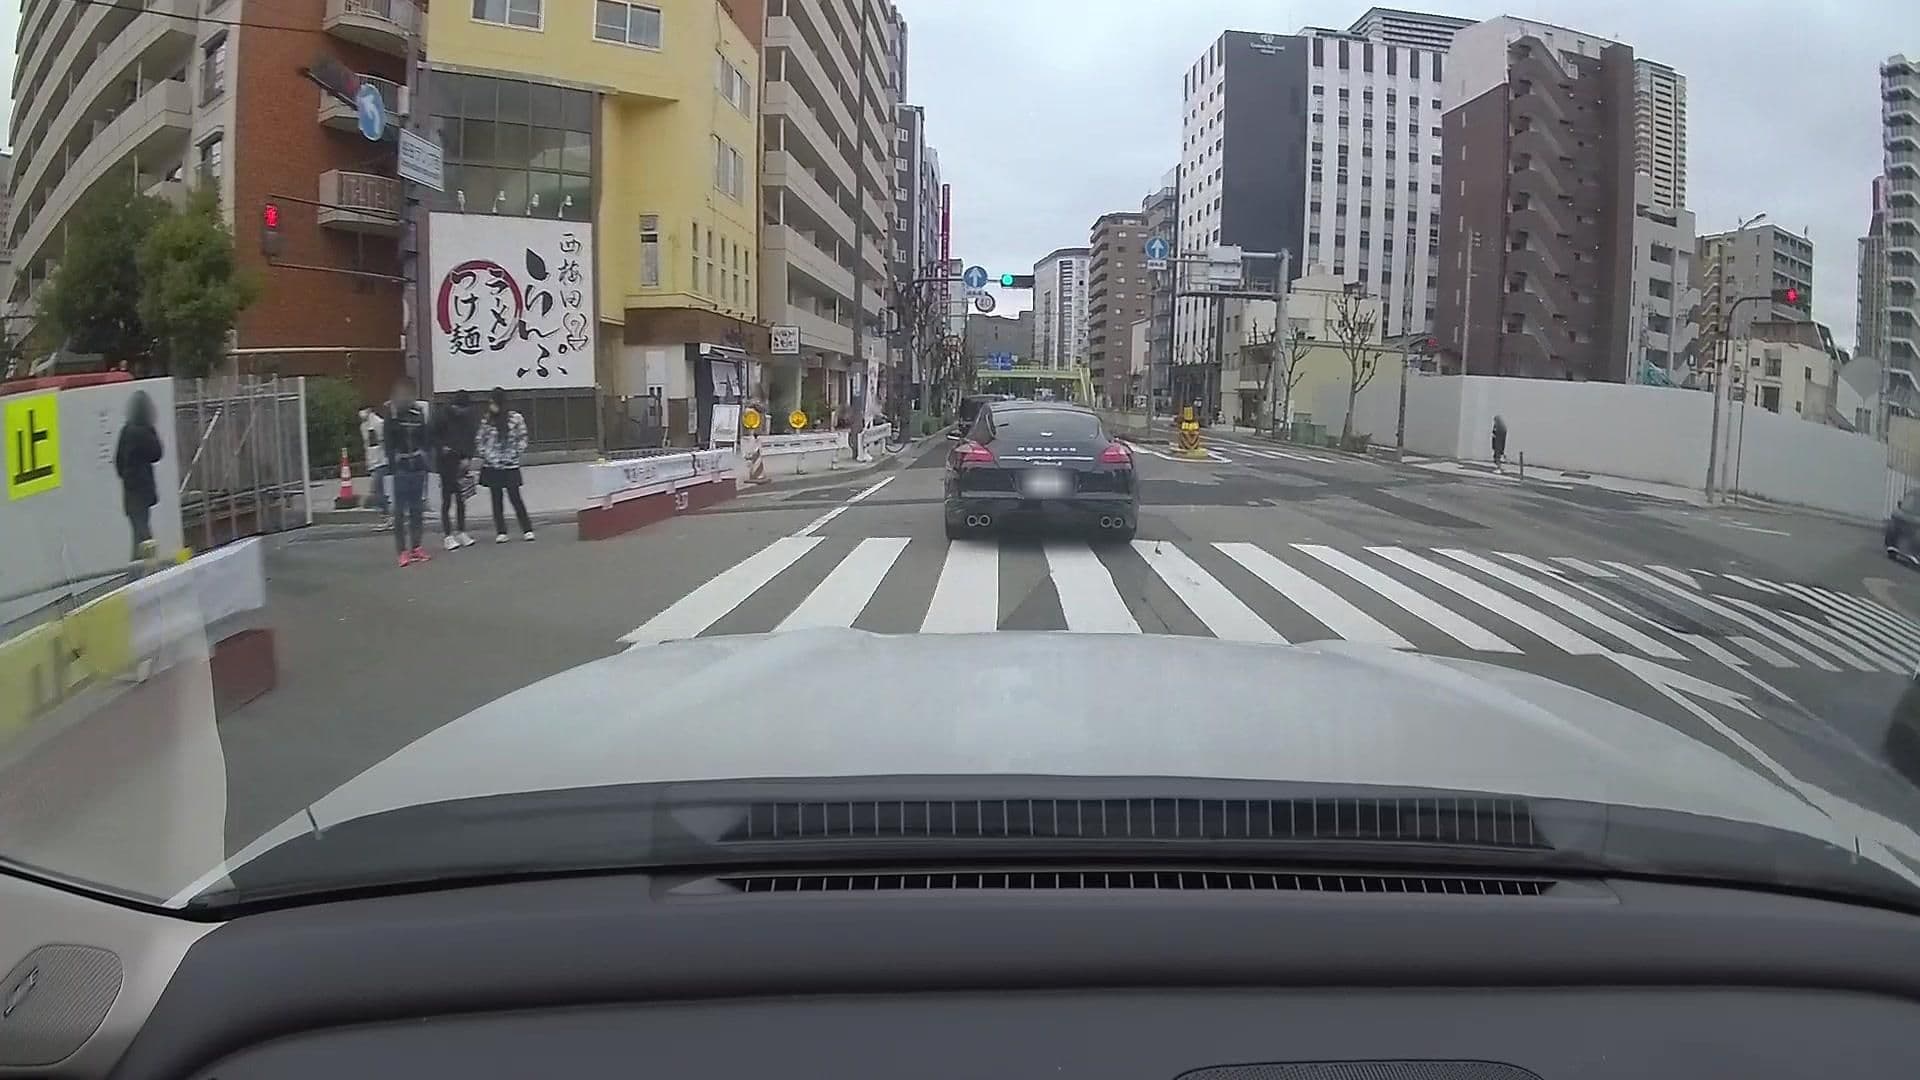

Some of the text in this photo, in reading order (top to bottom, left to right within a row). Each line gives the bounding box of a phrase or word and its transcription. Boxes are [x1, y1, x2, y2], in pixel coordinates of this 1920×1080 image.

[485, 267, 509, 351] ラーメン
[557, 233, 583, 309] 西梅田
[448, 270, 484, 355] つけ麺
[13, 408, 54, 486] 止
